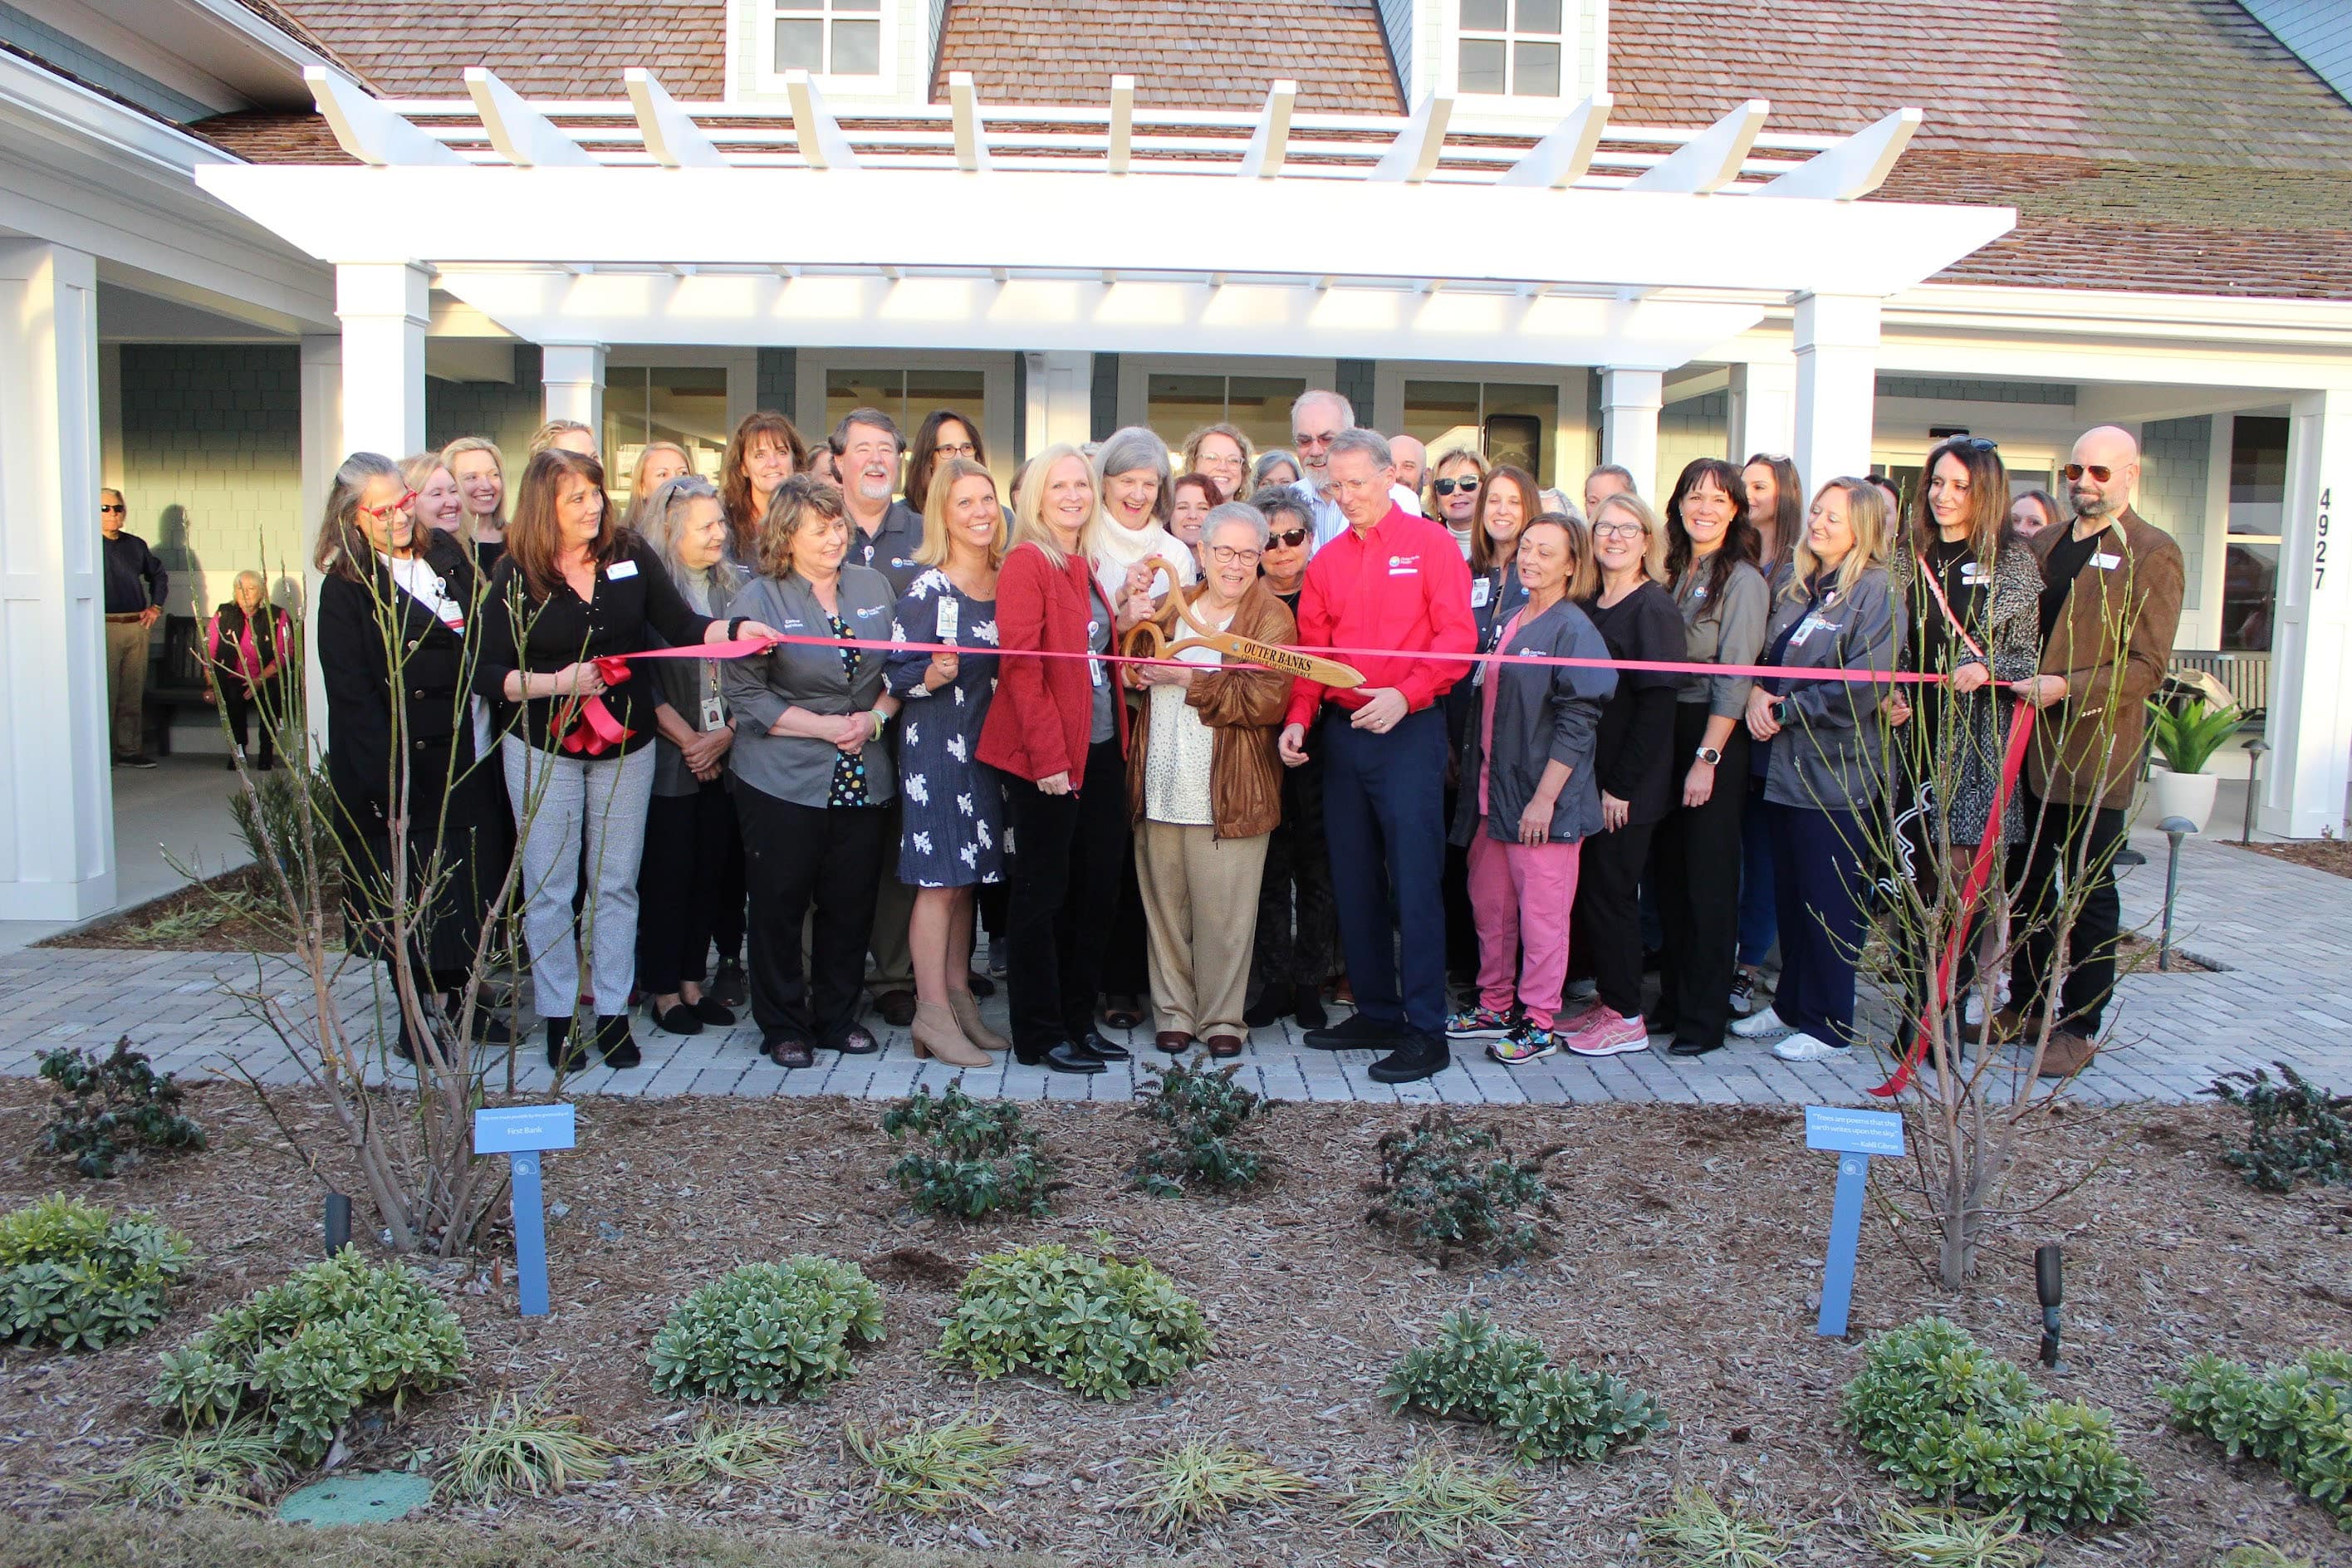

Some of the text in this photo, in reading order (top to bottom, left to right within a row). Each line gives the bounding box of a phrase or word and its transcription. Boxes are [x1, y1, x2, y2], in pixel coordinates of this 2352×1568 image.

[2315, 488, 2331, 590] 4927
[1244, 642, 1312, 672] OUTER BANKS
[507, 1126, 543, 1135] First Bank
